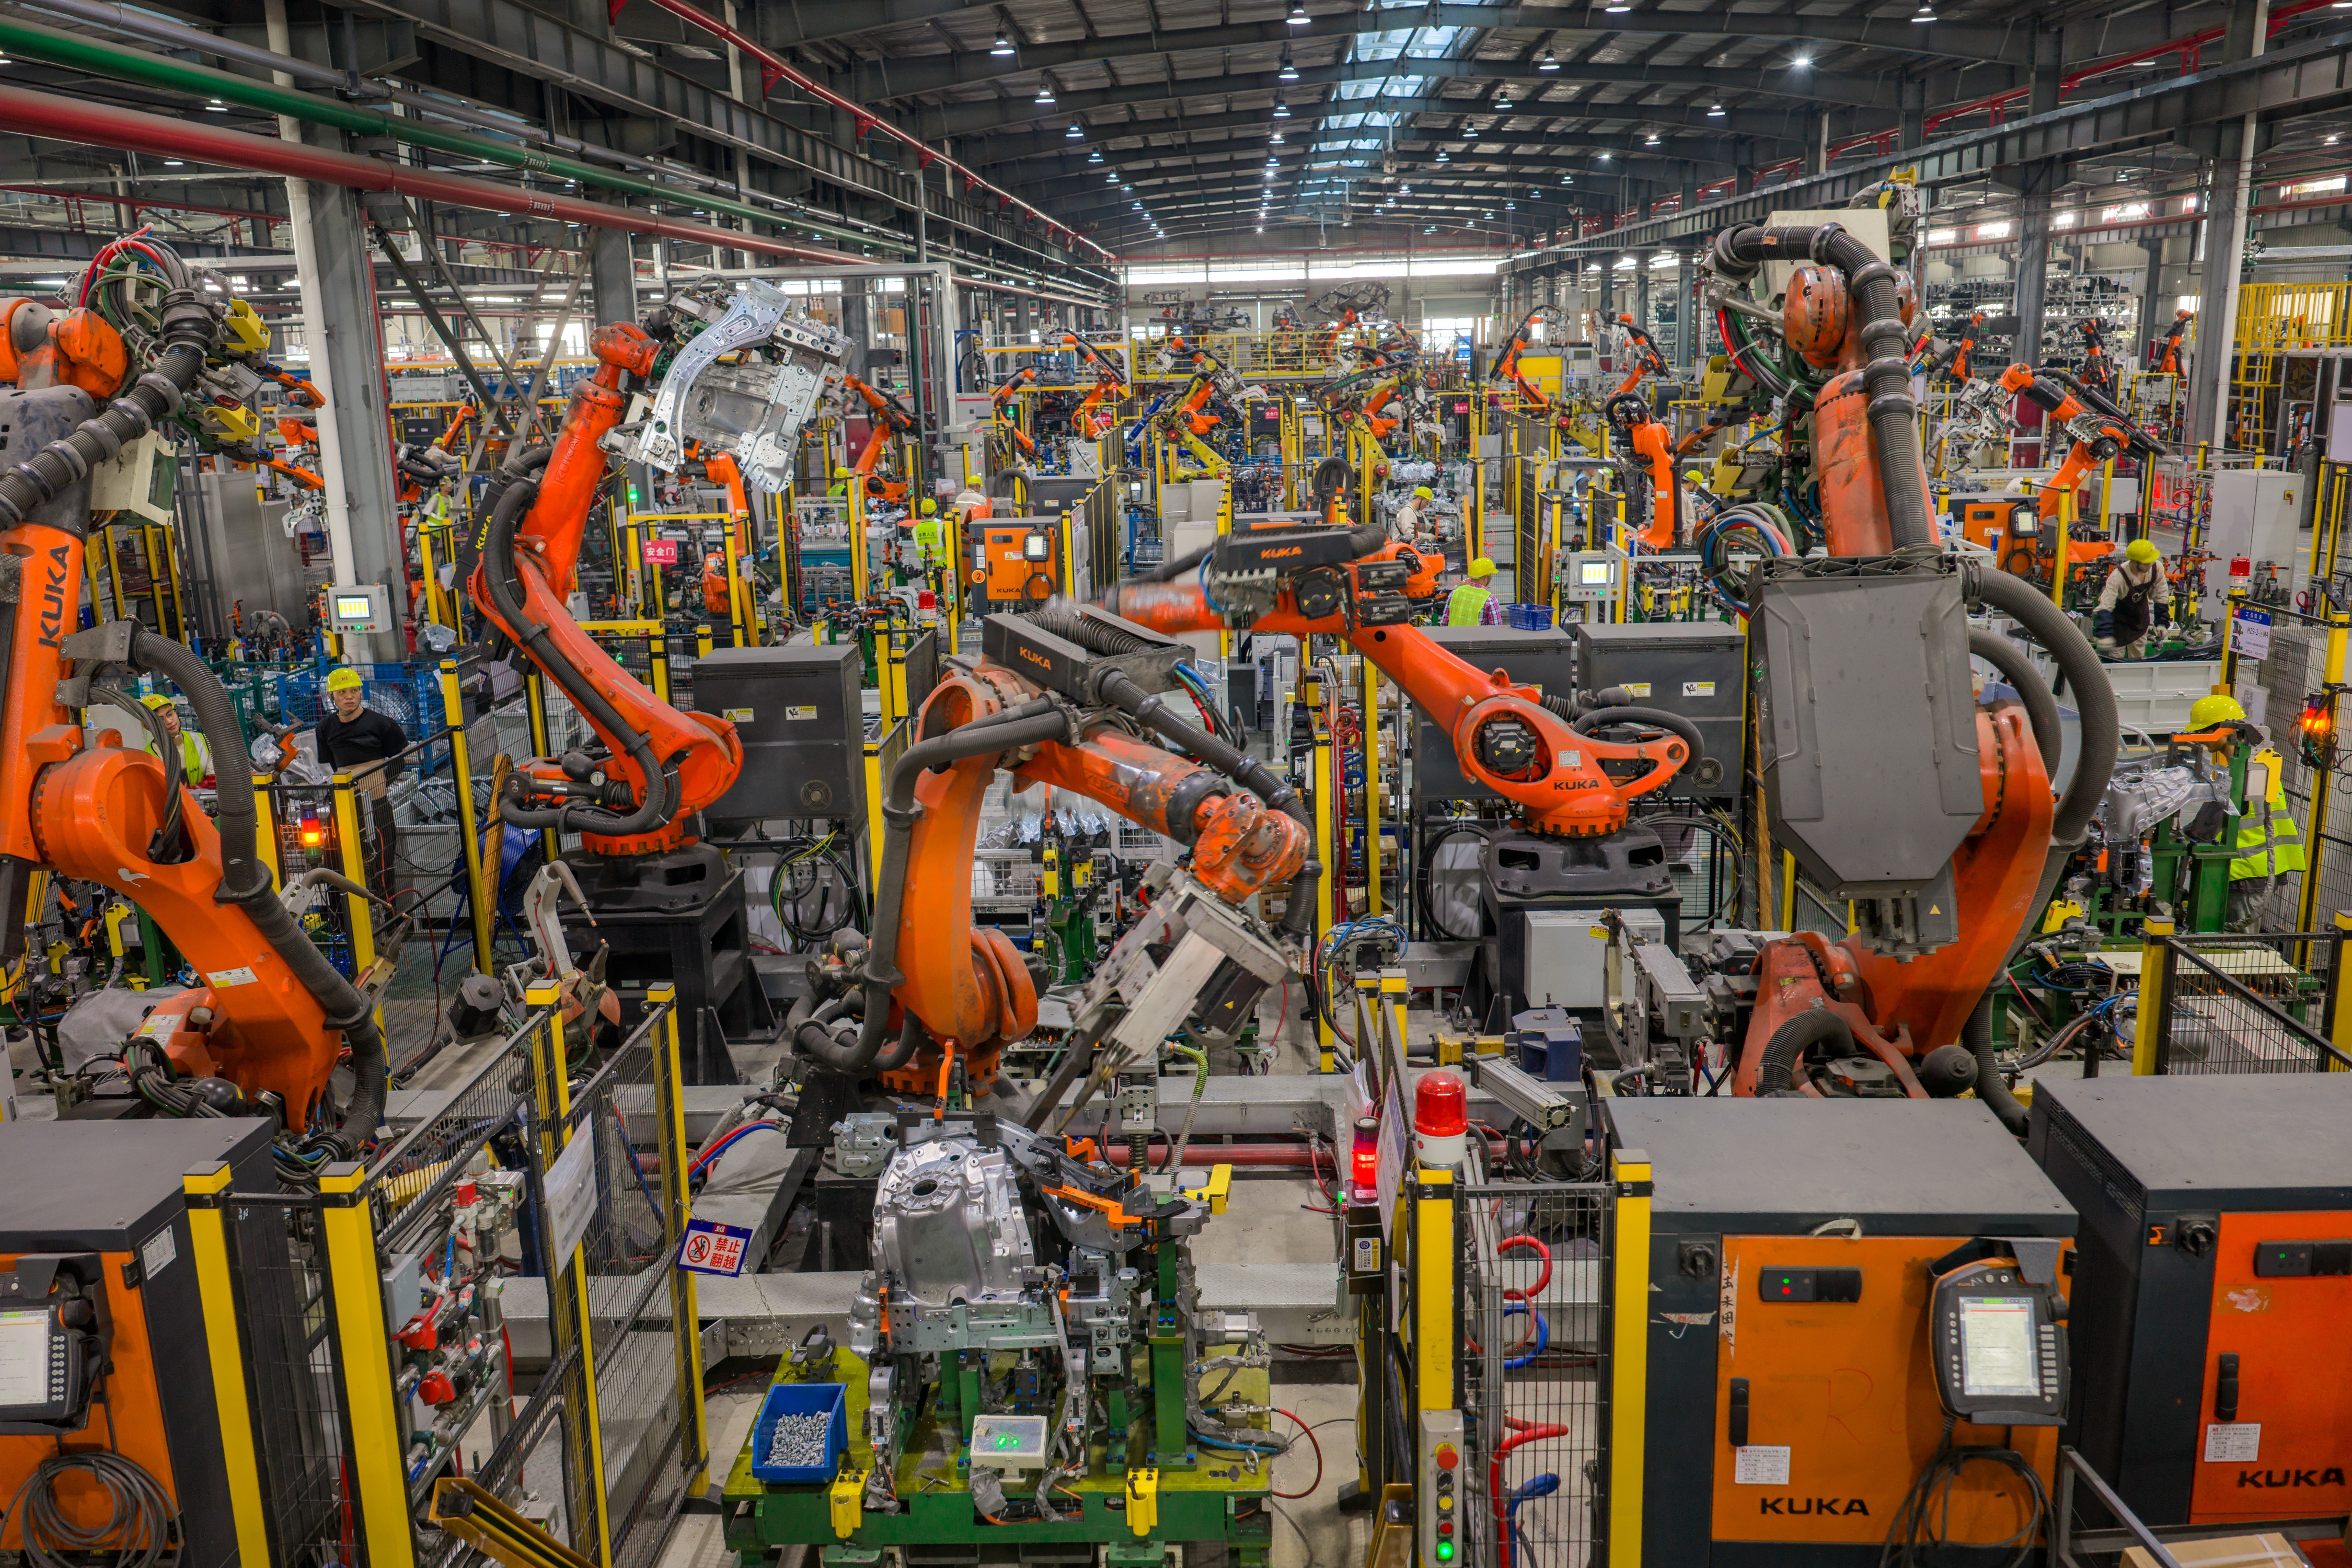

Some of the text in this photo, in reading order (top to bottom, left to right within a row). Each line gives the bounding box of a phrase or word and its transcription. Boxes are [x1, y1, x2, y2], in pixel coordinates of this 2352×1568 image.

[556, 440, 579, 483] KUKA
[475, 515, 492, 550] KUKA
[647, 547, 674, 556] 安全门
[1261, 546, 1303, 559] KUKA
[39, 545, 70, 649] KUKA
[1020, 647, 1052, 671] KUKA
[1554, 779, 1599, 790] KUKA
[143, 1238, 157, 1251] KUKA
[714, 1237, 740, 1254] 禁止
[709, 1253, 737, 1270] 翻越
[2238, 1468, 2345, 1488] KUKA
[1760, 1497, 1870, 1516] KUKA
